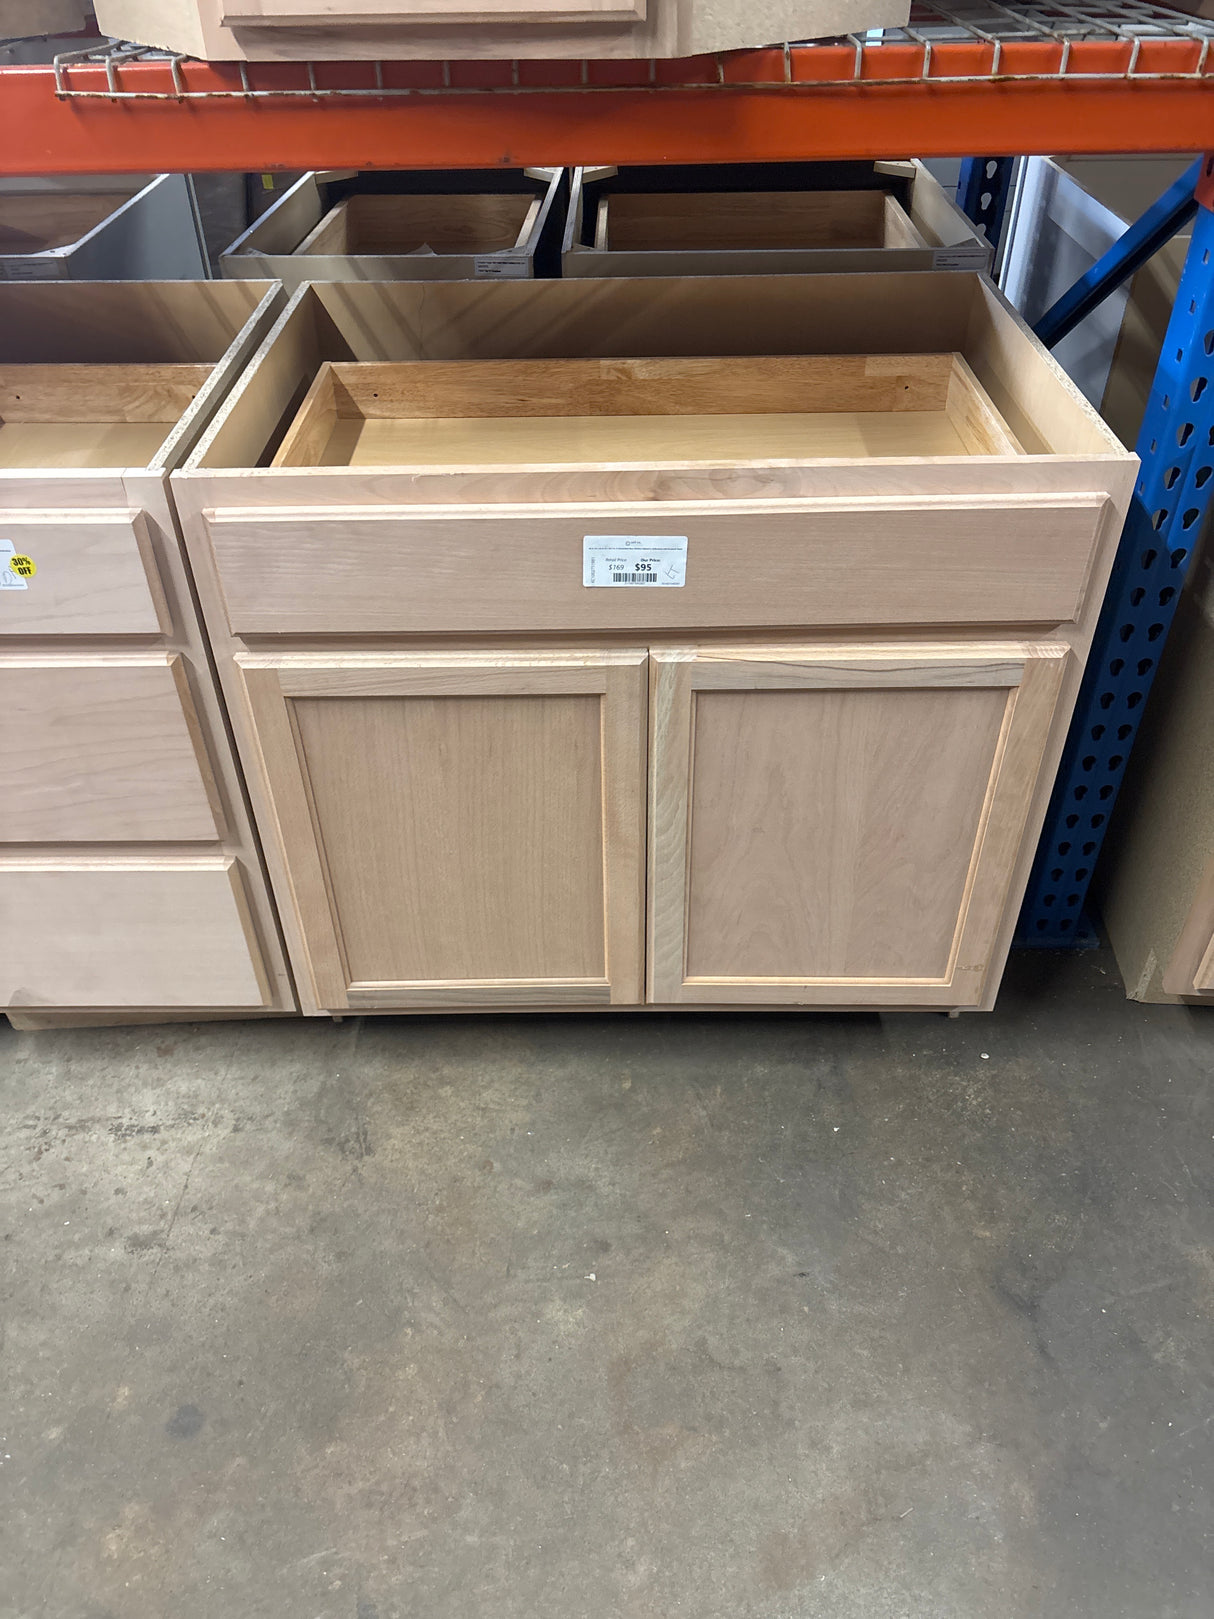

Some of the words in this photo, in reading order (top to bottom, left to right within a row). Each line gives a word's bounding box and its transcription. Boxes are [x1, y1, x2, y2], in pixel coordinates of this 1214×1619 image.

[12, 557, 31, 566] 30%
[18, 567, 32, 575] OFF
[635, 563, 652, 572] $95
